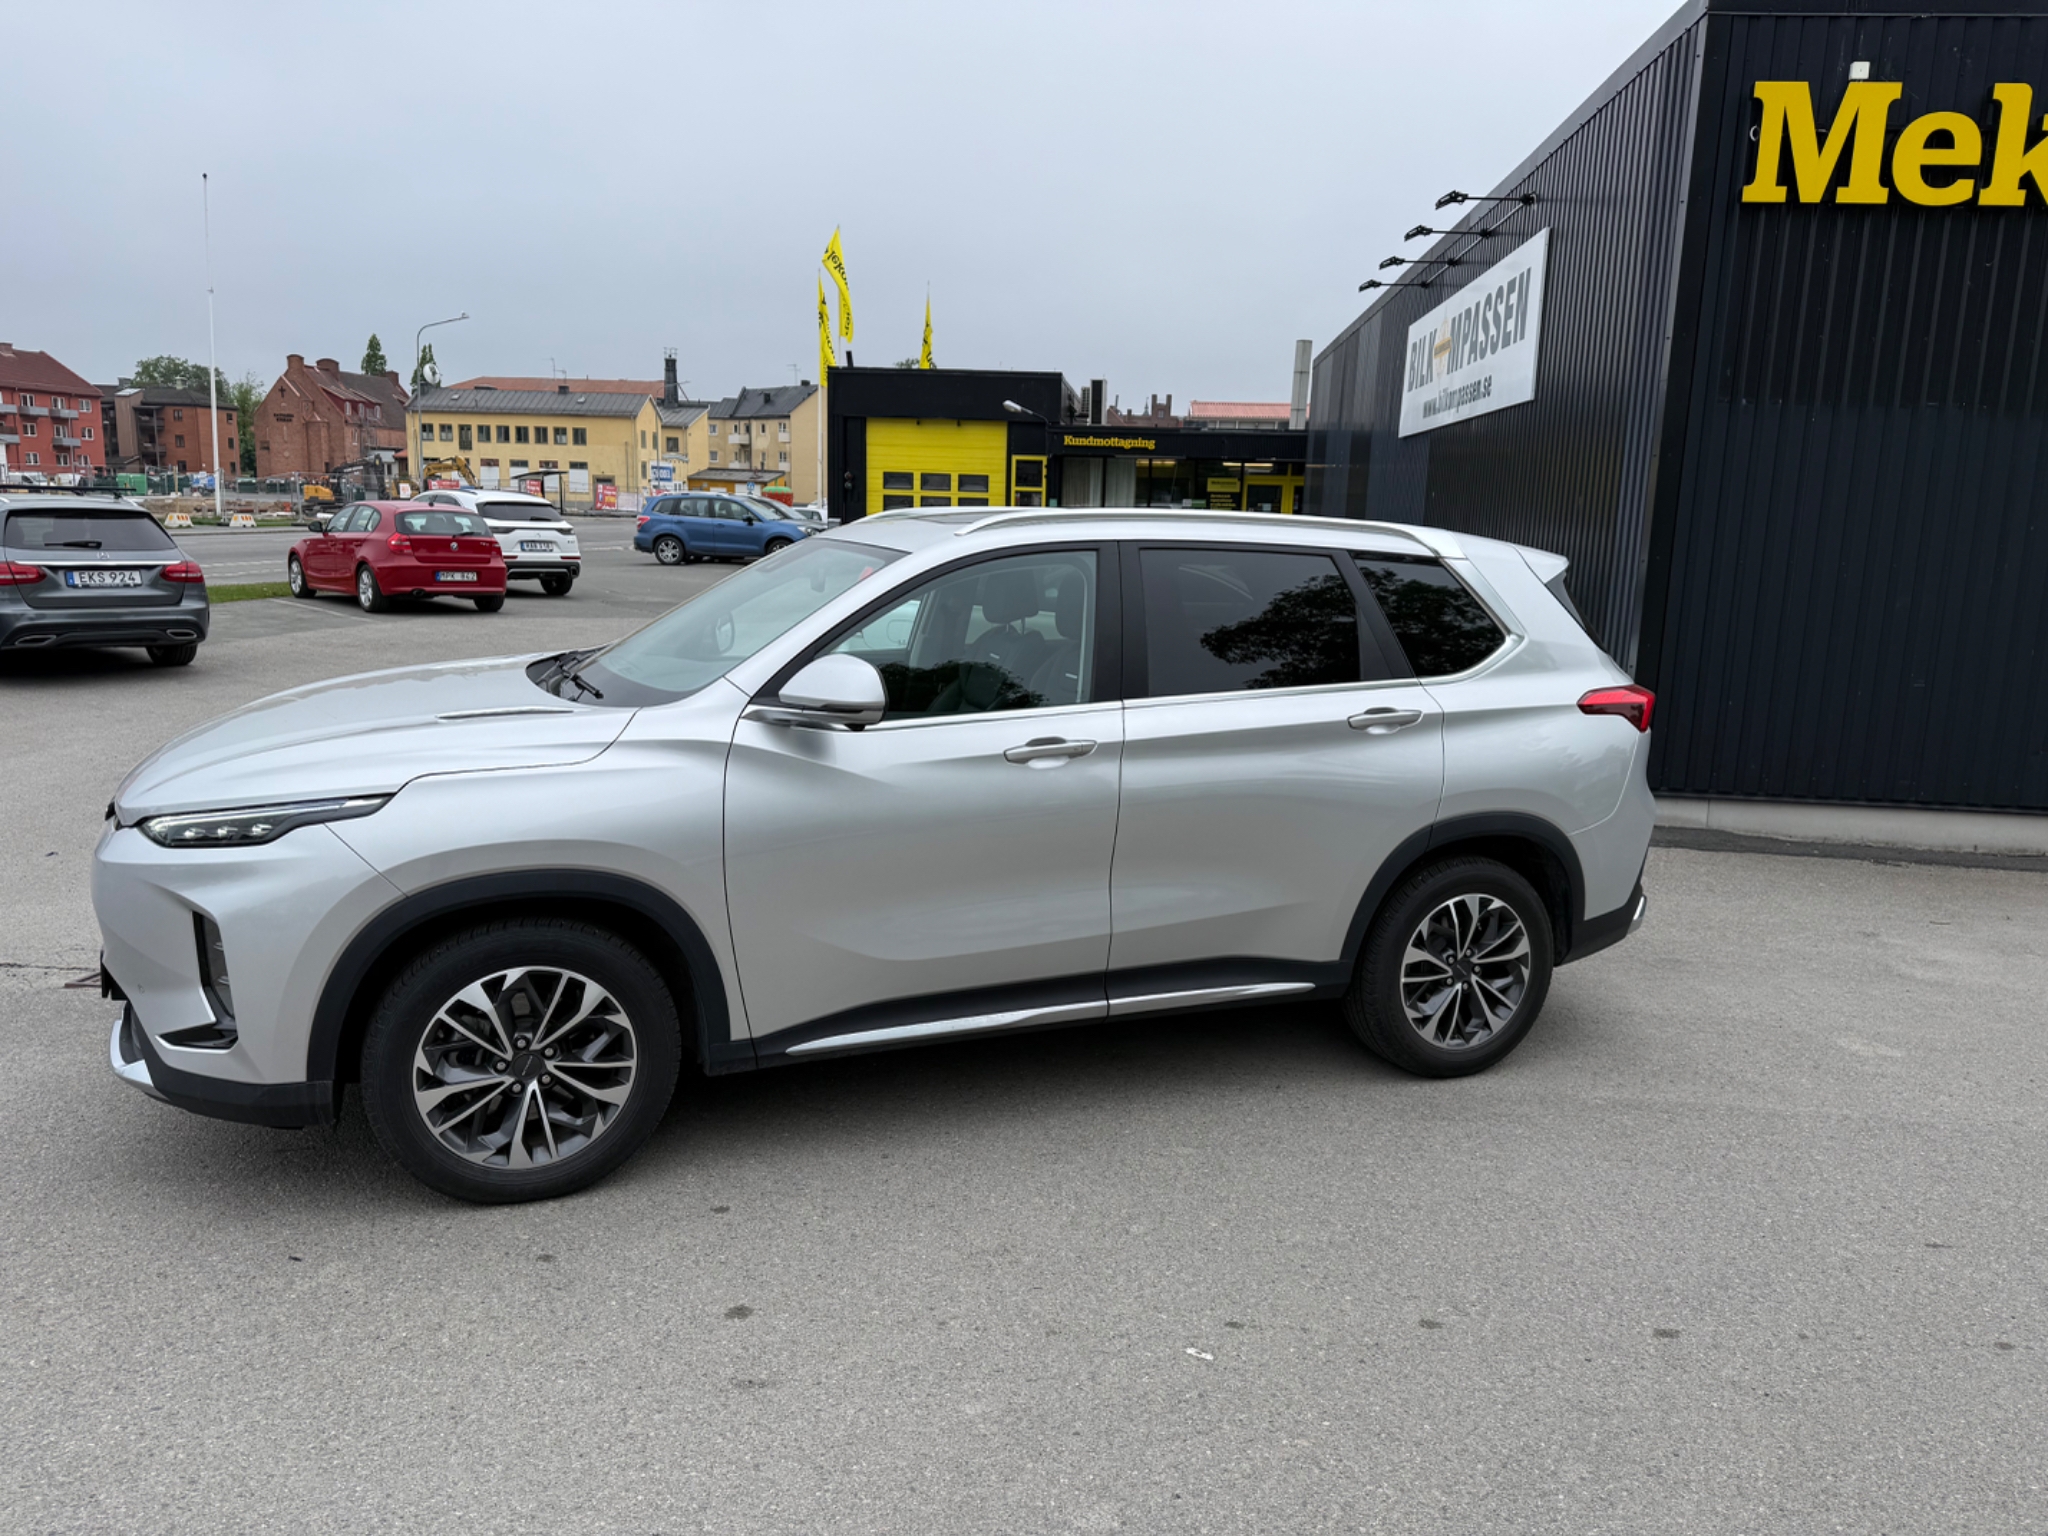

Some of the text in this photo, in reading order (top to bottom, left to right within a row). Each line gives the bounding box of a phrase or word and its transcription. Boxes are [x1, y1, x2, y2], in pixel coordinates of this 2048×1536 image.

[1741, 81, 2048, 206] Mek
[1063, 435, 1156, 450] Kundmottagning
[79, 571, 136, 583] EKS 924
